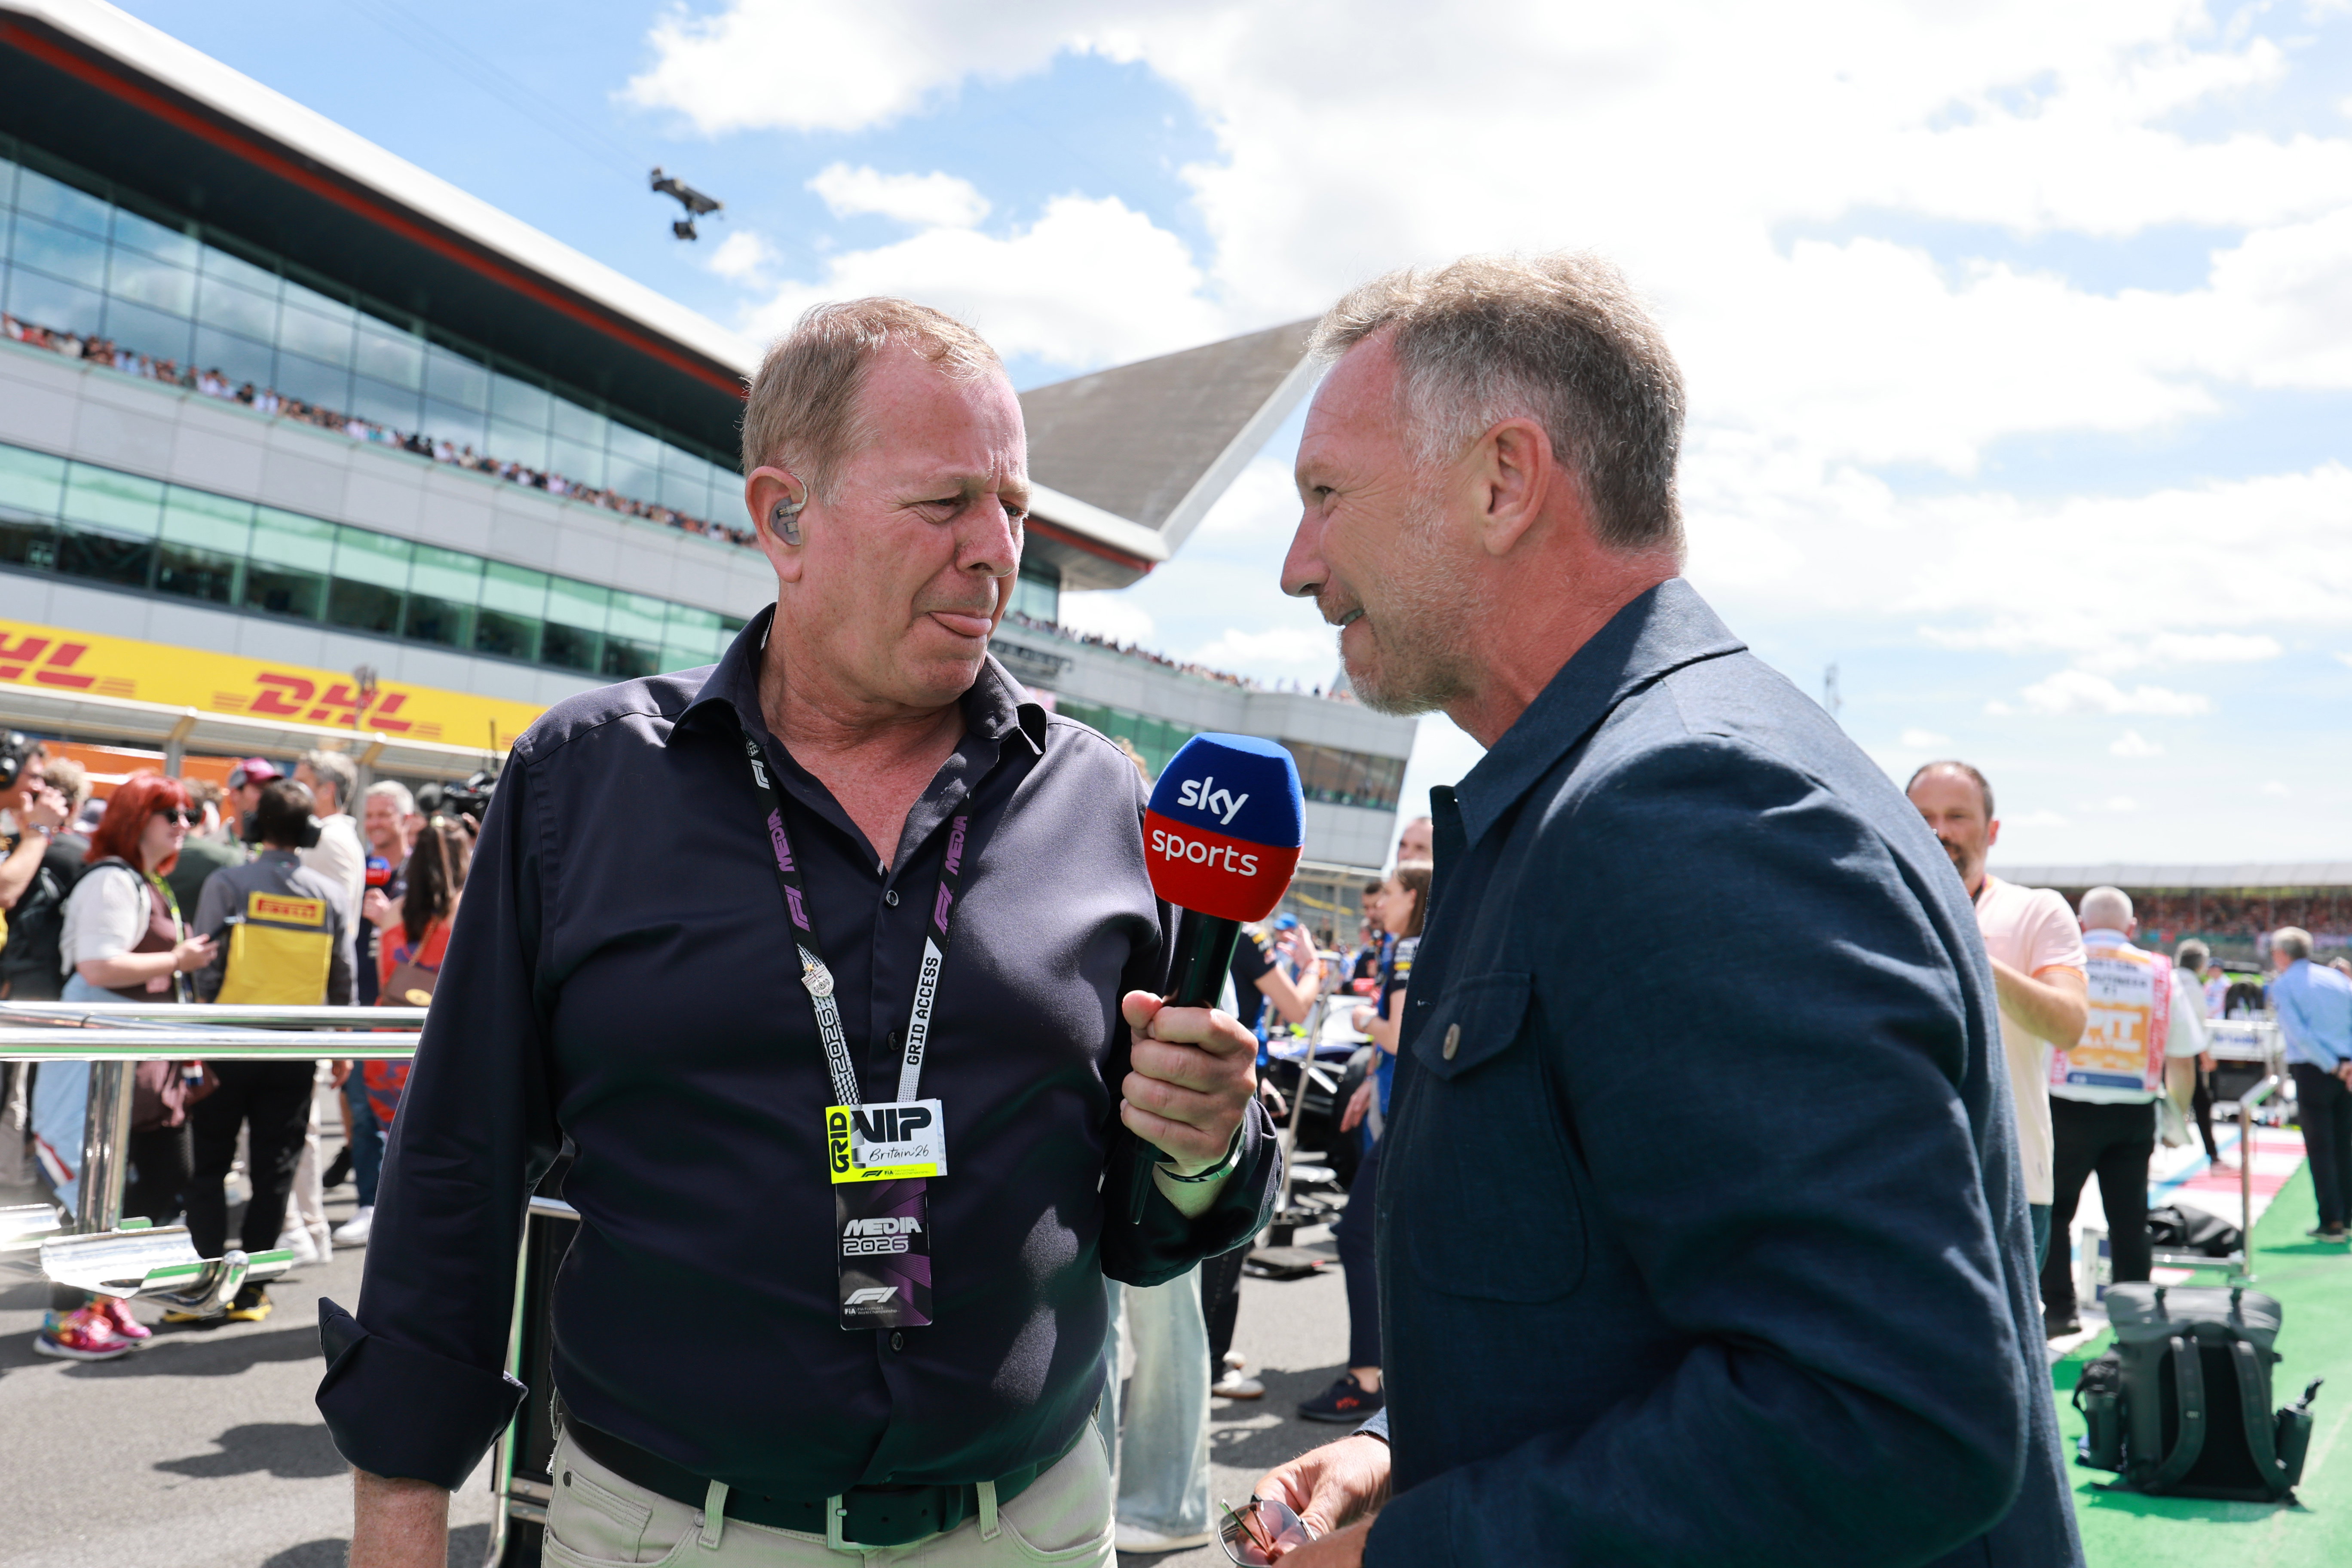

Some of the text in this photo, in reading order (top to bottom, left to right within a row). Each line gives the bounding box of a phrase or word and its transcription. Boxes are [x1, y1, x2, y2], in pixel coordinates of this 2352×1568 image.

[249, 673, 413, 732] DHL
[1177, 776, 1249, 825] sky
[767, 807, 795, 871] MEDIA
[945, 816, 968, 876] MEDIA
[1152, 830, 1259, 876] sports
[906, 957, 939, 1066] GRID ACCESS
[817, 1008, 849, 1076] 2026
[830, 1112, 850, 1173] GRID
[851, 1107, 932, 1143] VIP
[843, 1216, 922, 1237] MEDIA
[843, 1235, 909, 1256] 2026
